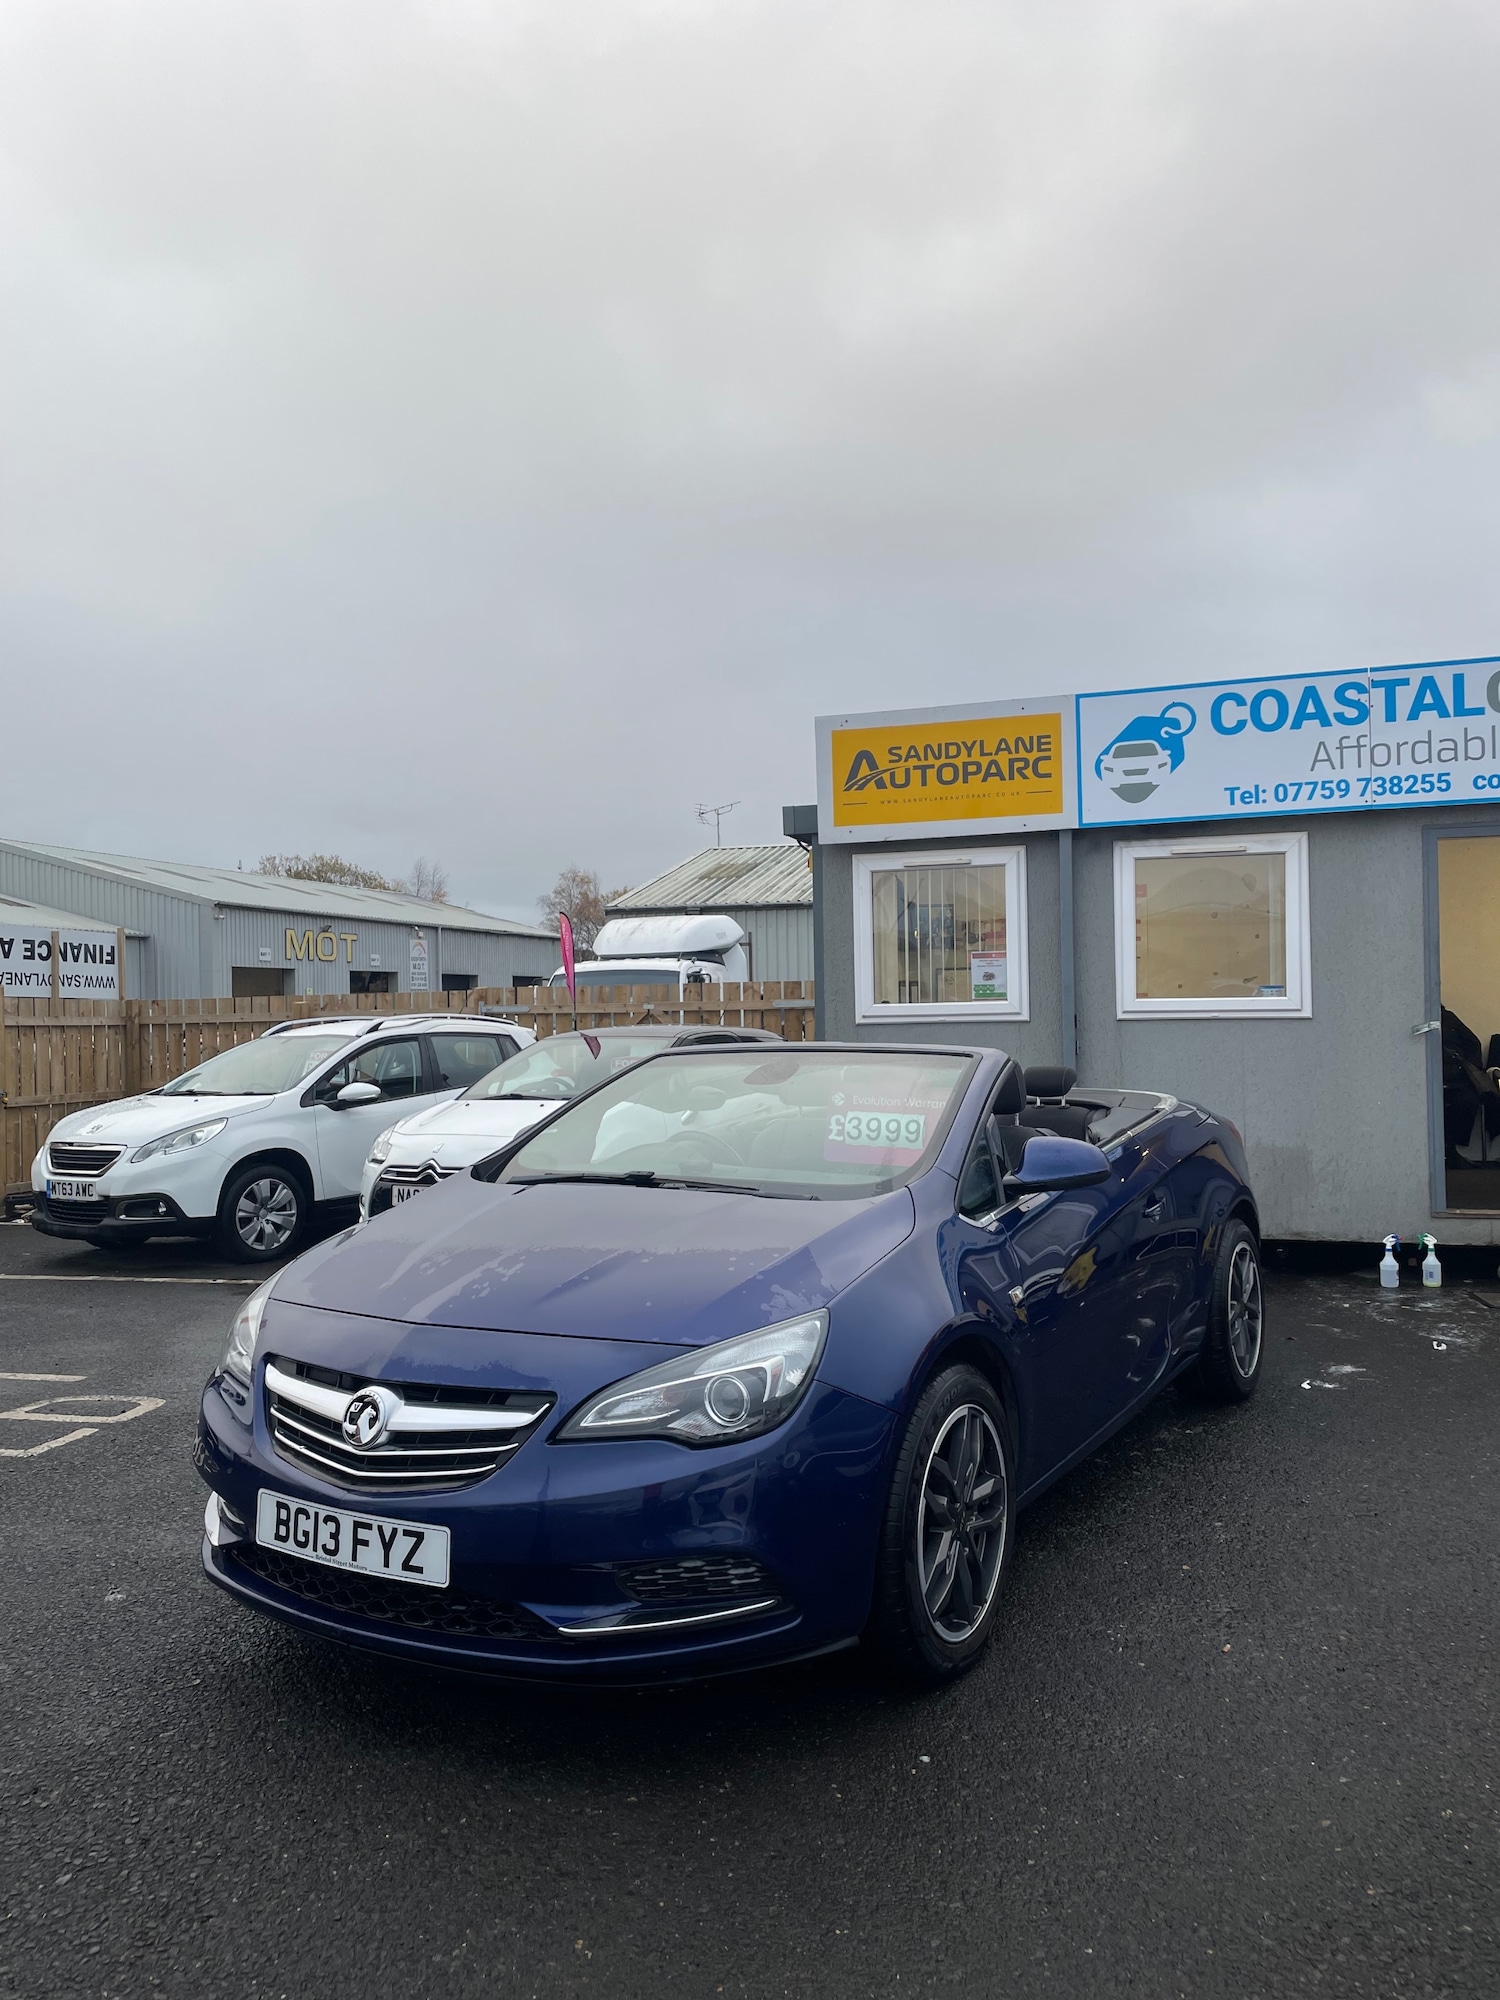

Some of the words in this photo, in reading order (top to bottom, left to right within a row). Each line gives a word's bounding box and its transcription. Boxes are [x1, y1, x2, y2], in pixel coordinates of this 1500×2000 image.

[888, 734, 1052, 764] SANDYLANE
[1310, 725, 1497, 771] Affordabl
[842, 749, 1052, 791] AUTOPARC
[1224, 784, 1267, 805] Tel:
[1274, 778, 1350, 802] 07759
[1356, 772, 1451, 797] 738255
[22, 938, 116, 965] FINANCE
[284, 927, 358, 963] MOT
[852, 1095, 901, 1107] Evolution
[828, 1114, 922, 1144] £3999
[51, 1181, 73, 1196] MT63
[76, 1183, 94, 1197] AWC
[274, 1500, 341, 1557] BG13
[351, 1519, 425, 1574] FYZ
